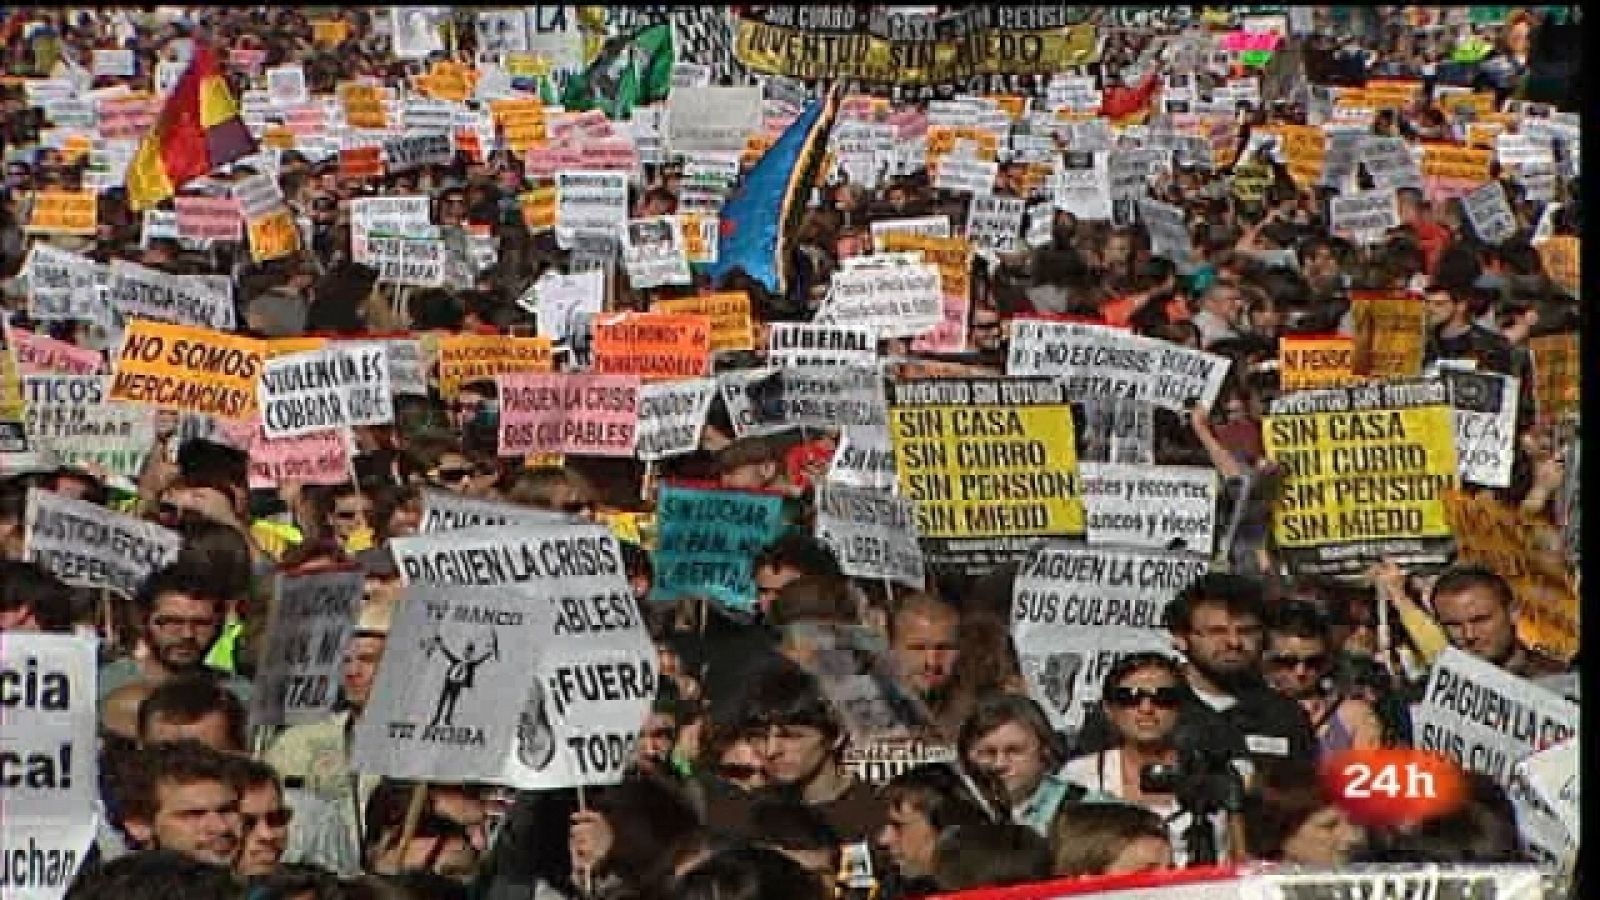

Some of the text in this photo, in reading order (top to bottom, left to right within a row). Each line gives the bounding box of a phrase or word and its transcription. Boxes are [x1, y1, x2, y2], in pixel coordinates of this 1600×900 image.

[122, 334, 262, 379] NO SOMOS
[266, 390, 346, 431] COBRAR
[899, 408, 1027, 438] SIN CASA
[1271, 411, 1406, 447] SIN CASA
[904, 440, 1047, 468] SIN CURRO
[1276, 445, 1428, 477] SIN CURRO
[909, 473, 952, 501] SIN
[1281, 481, 1325, 511] SIN
[916, 503, 1049, 532] SIN MIEDO
[1282, 512, 1329, 541] SIN
[1339, 509, 1424, 538] MIEDO
[402, 536, 618, 588] PAGUEN LA CRISIS
[1018, 550, 1102, 586] PAGUEN
[1109, 553, 1134, 588] LA
[1015, 591, 1058, 625] SUS
[0, 656, 71, 711] cia
[1431, 667, 1512, 735] PAGUEN
[1422, 724, 1465, 768] SUS
[0, 743, 71, 790] ca!
